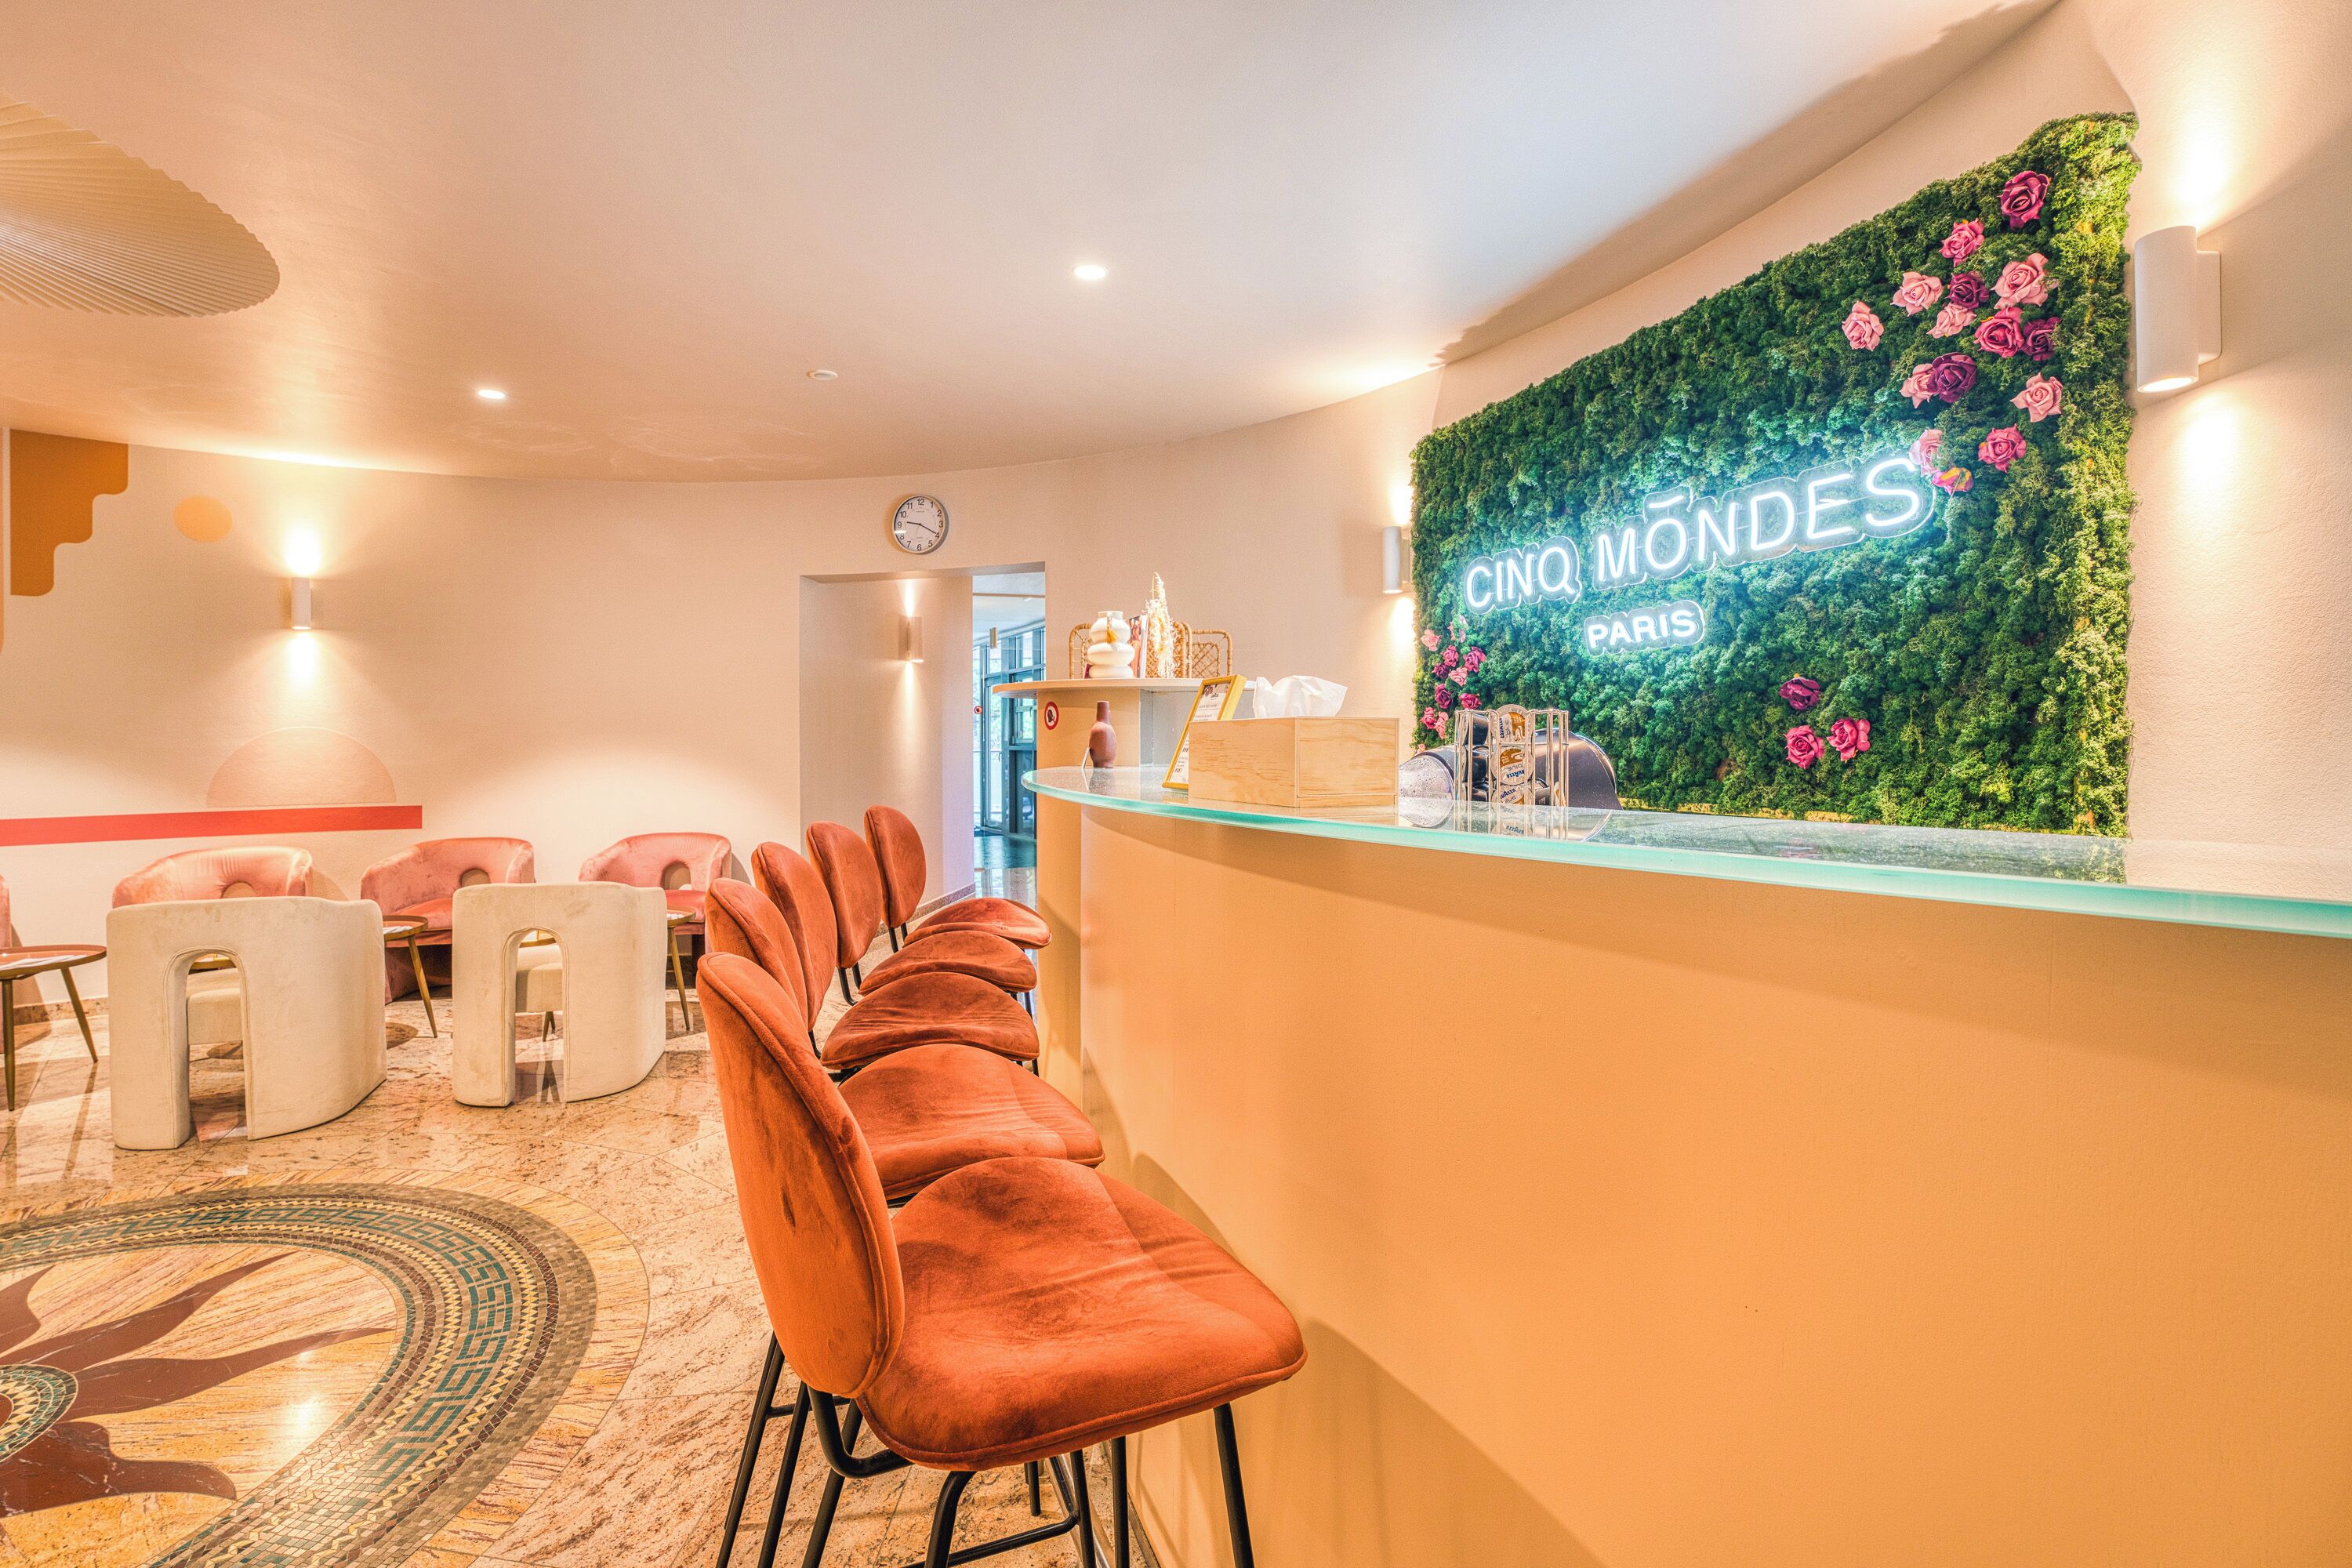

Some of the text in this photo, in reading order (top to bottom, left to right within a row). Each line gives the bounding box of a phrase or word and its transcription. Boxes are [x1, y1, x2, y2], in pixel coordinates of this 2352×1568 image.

[1466, 546, 1576, 608] CINQ
[1587, 609, 1698, 648] PARIS
[1506, 769, 1525, 779] AVAZZA
